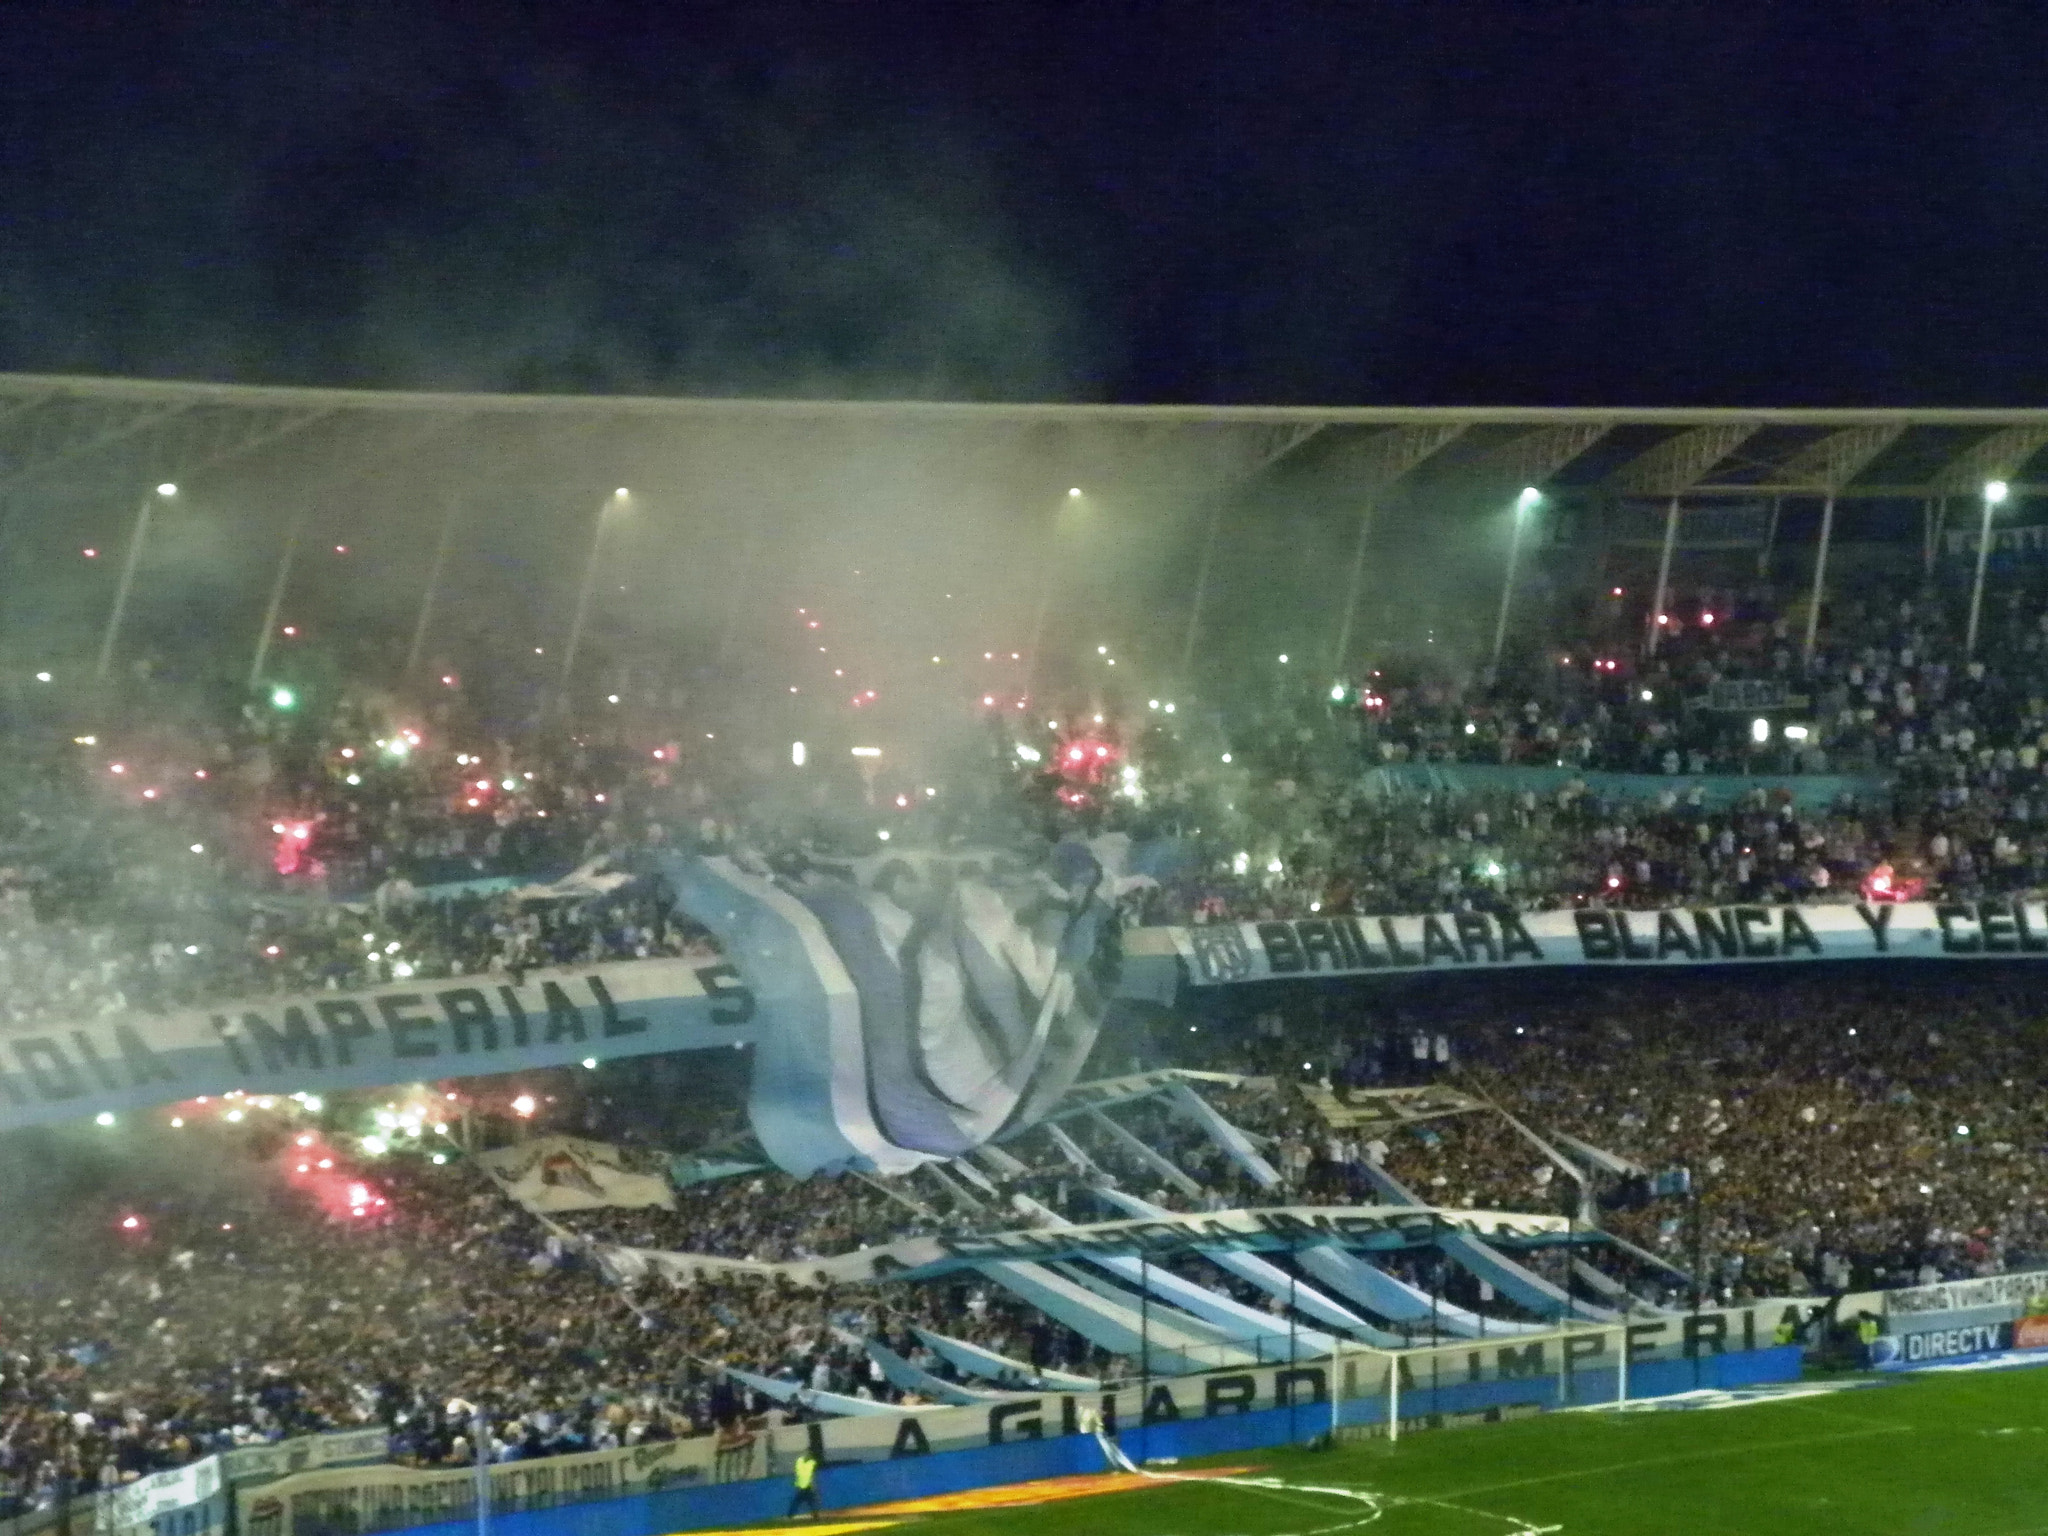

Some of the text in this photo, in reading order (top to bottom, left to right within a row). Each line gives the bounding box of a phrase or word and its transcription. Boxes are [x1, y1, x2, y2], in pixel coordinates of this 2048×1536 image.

[1574, 904, 1822, 960] BLANCA
[1855, 903, 1893, 952] Y
[0, 1022, 182, 1106] DIA
[208, 974, 648, 1077] IMPERIAL
[1467, 1303, 1822, 1383] IMPERIA
[1908, 1323, 2000, 1361] DIRECTV
